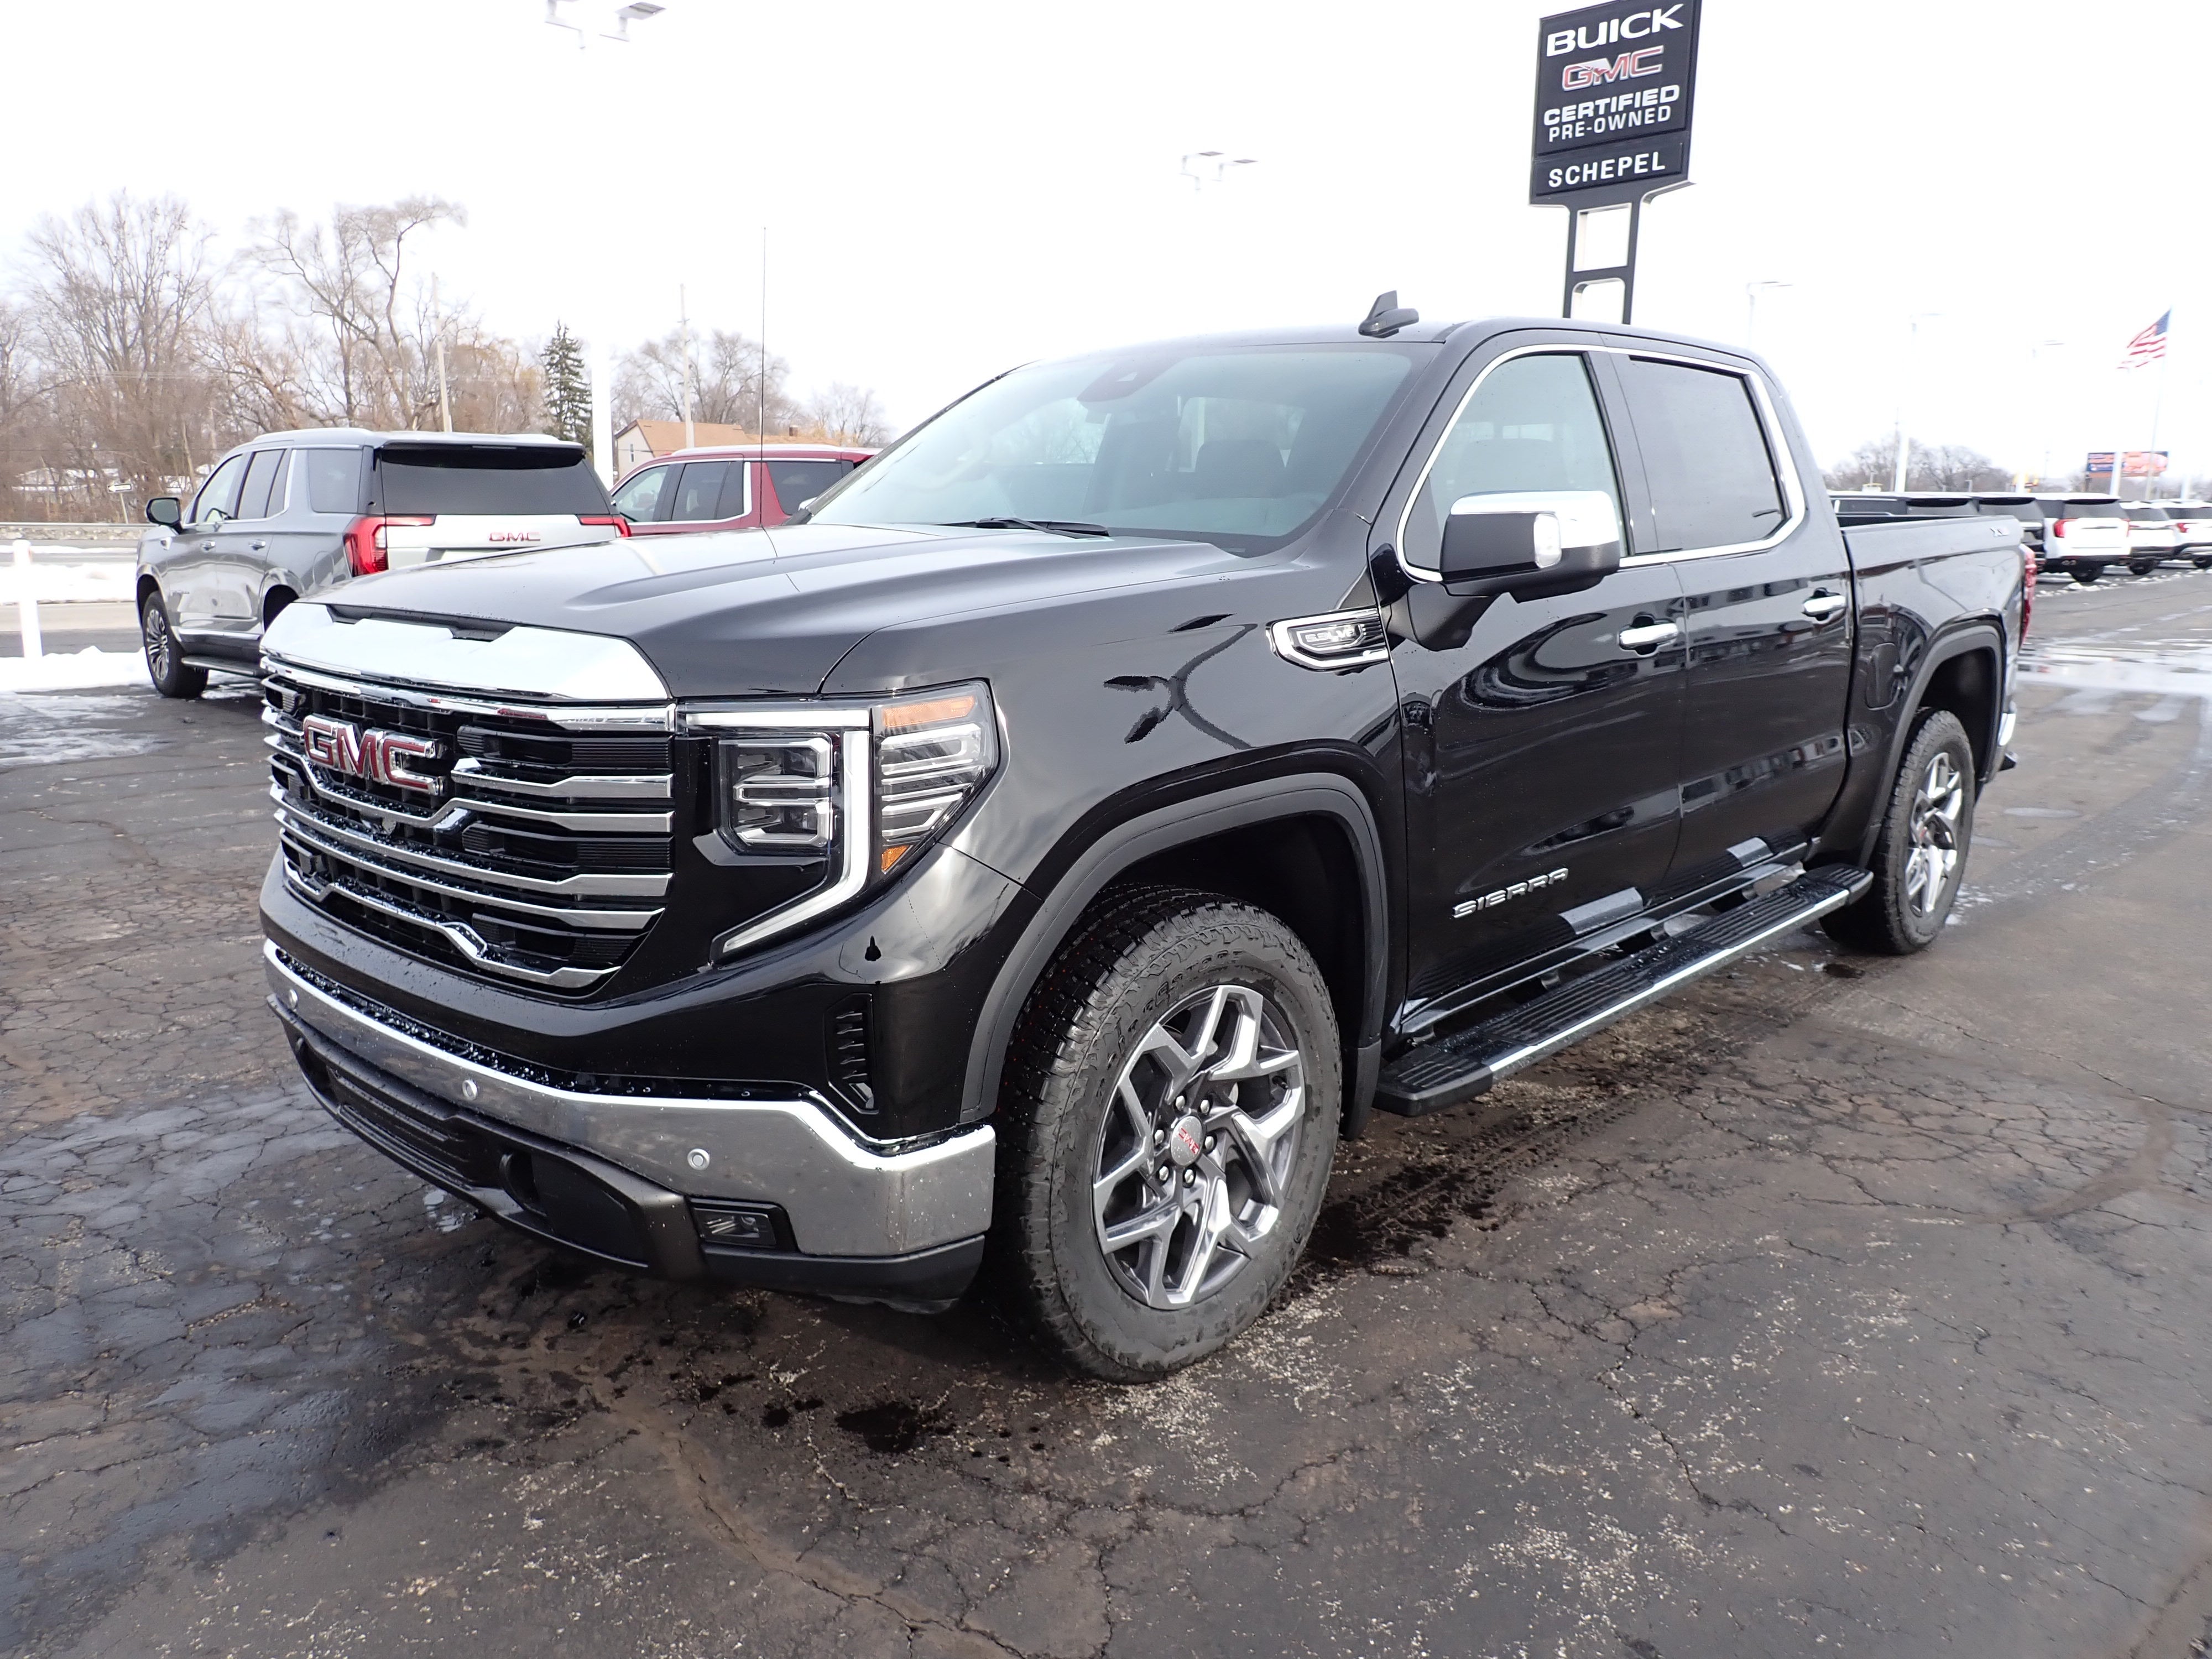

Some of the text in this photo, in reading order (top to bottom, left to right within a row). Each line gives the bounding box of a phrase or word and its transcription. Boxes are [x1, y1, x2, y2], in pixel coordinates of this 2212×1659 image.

[1546, 3, 1684, 57] BUICK
[1562, 45, 1664, 91] GMC
[1543, 85, 1680, 126] CERTIFIED
[1549, 106, 1671, 142] PRE-OWNED
[1548, 152, 1666, 188] SCHEPEL
[489, 531, 541, 542] GMC
[304, 714, 444, 796] GMC
[1452, 868, 1569, 919] SIERRA
[1178, 1126, 1200, 1155] GMC
